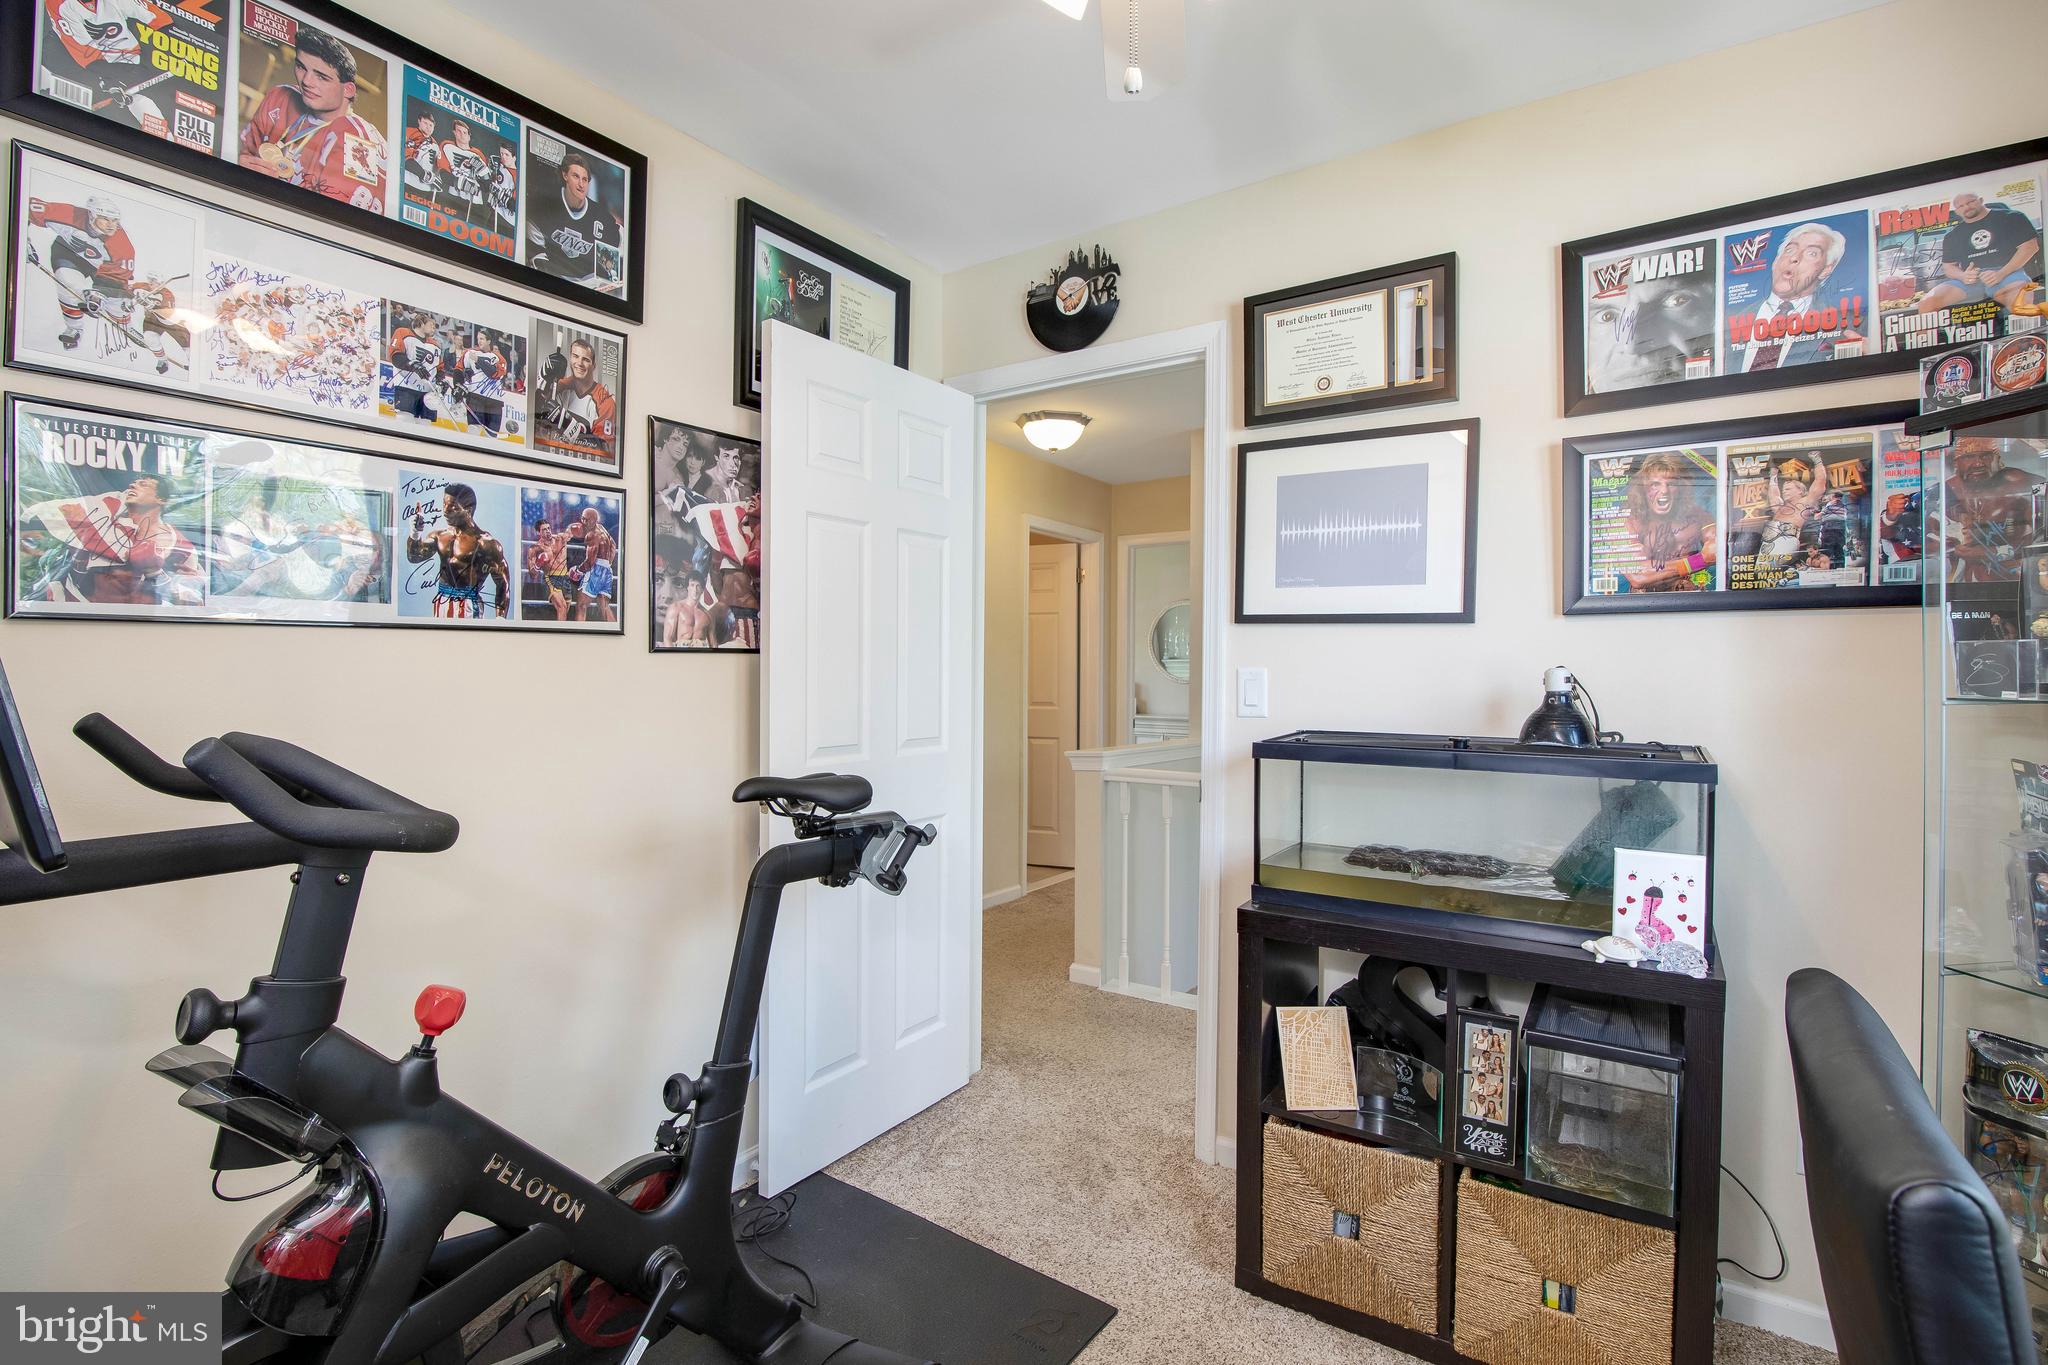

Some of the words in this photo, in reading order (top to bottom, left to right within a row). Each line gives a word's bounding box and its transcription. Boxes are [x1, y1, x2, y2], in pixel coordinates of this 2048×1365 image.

[155, 0, 216, 32] YEARBOOK
[254, 5, 288, 26] BECKETT
[255, 13, 288, 33] HOCKEY
[253, 20, 289, 41] MONTHLY
[135, 22, 220, 73] YOUNG
[151, 50, 218, 91] GUNS
[429, 80, 500, 126] BECKETT
[177, 124, 212, 147] STATS
[178, 111, 213, 135] FULL
[443, 205, 457, 215] OF
[428, 208, 514, 257] DOOM
[553, 229, 592, 255] KINGS
[593, 220, 604, 239] C
[1631, 247, 1705, 294] WAR!
[1277, 318, 1297, 328] West
[1297, 313, 1328, 324] Chester
[1329, 303, 1373, 317] University
[1884, 308, 1950, 336] Gimme
[1817, 330, 1841, 340] Power
[1885, 335, 1899, 353] A
[1905, 330, 1939, 350] Hell
[1944, 318, 1995, 344] Yeah!
[33, 417, 116, 438] SYLVESTER
[126, 430, 193, 448] STALLONE
[41, 430, 147, 473] ROCKY
[157, 445, 187, 477] IV
[401, 476, 420, 498] To
[1732, 555, 1755, 563] ONE
[1732, 572, 1755, 581] ONE
[1757, 571, 1795, 580] MAN'S
[1732, 580, 1777, 590] DESTINY
[483, 1152, 586, 1224] PELOTON
